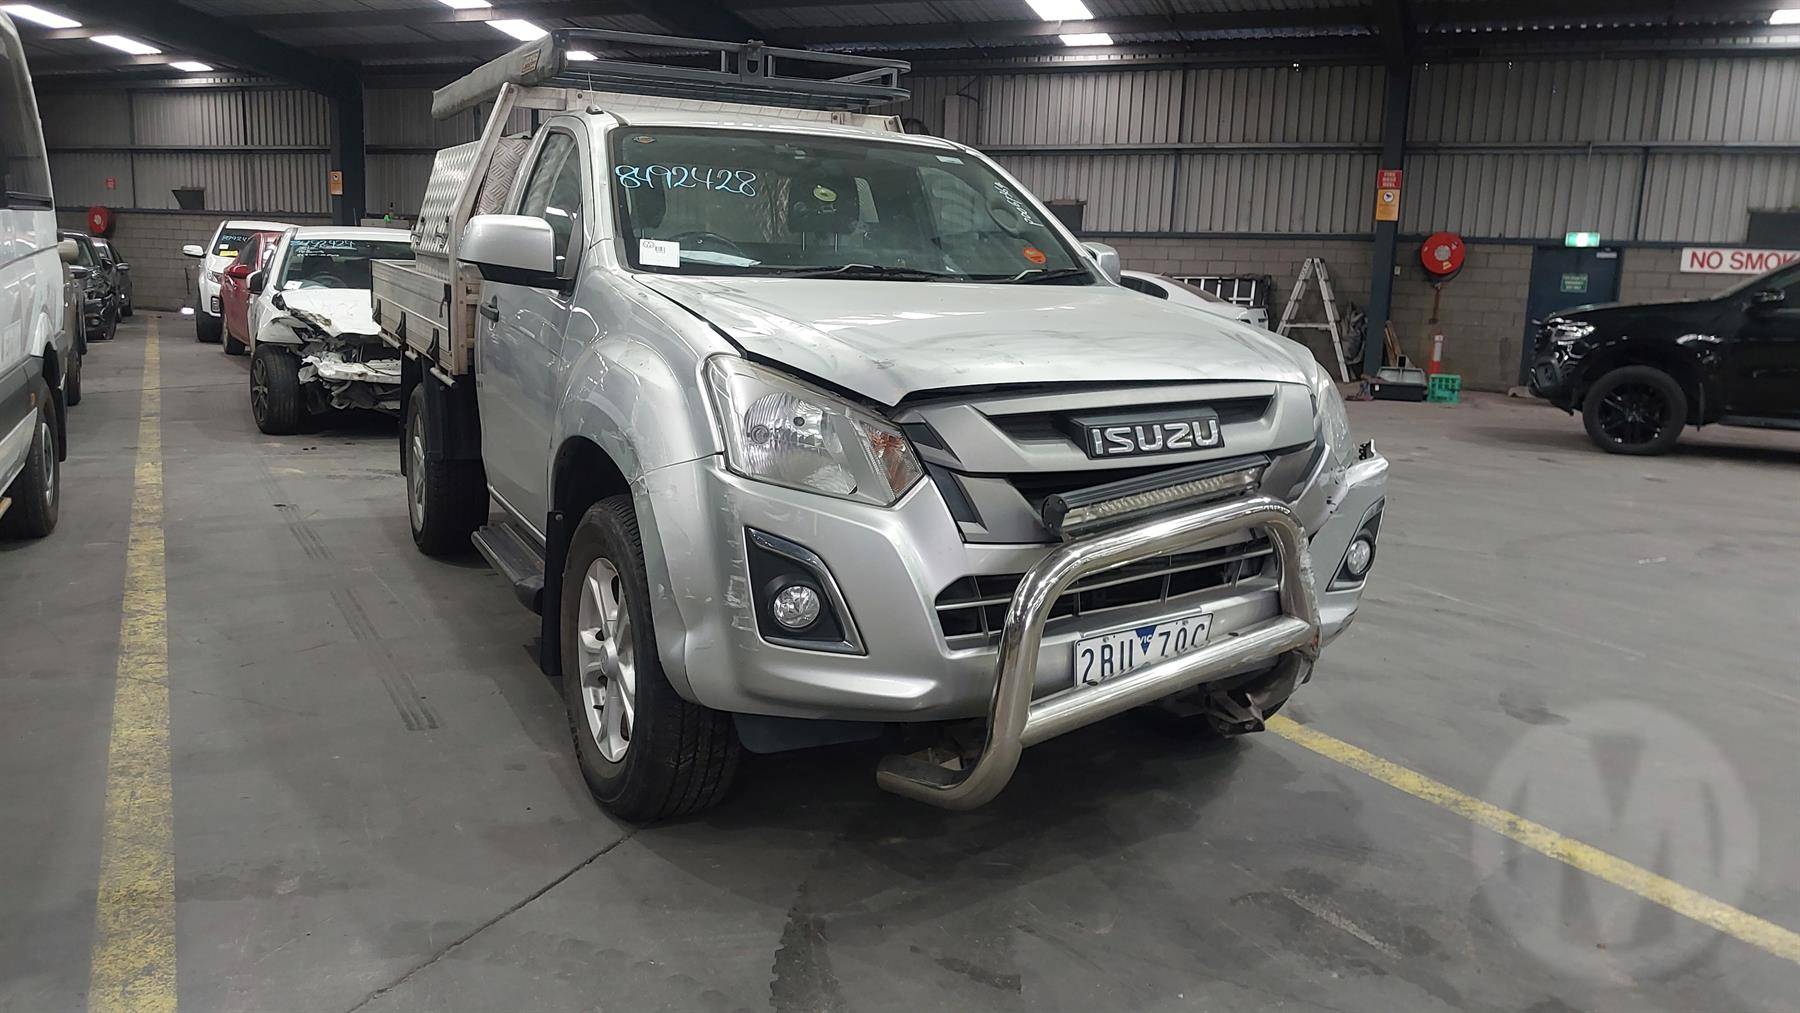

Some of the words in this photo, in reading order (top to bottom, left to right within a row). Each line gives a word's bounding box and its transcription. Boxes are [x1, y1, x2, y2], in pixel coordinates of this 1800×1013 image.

[614, 164, 757, 197] 8492428
[1690, 251, 1723, 269] NO
[1092, 419, 1219, 454] ISUZU
